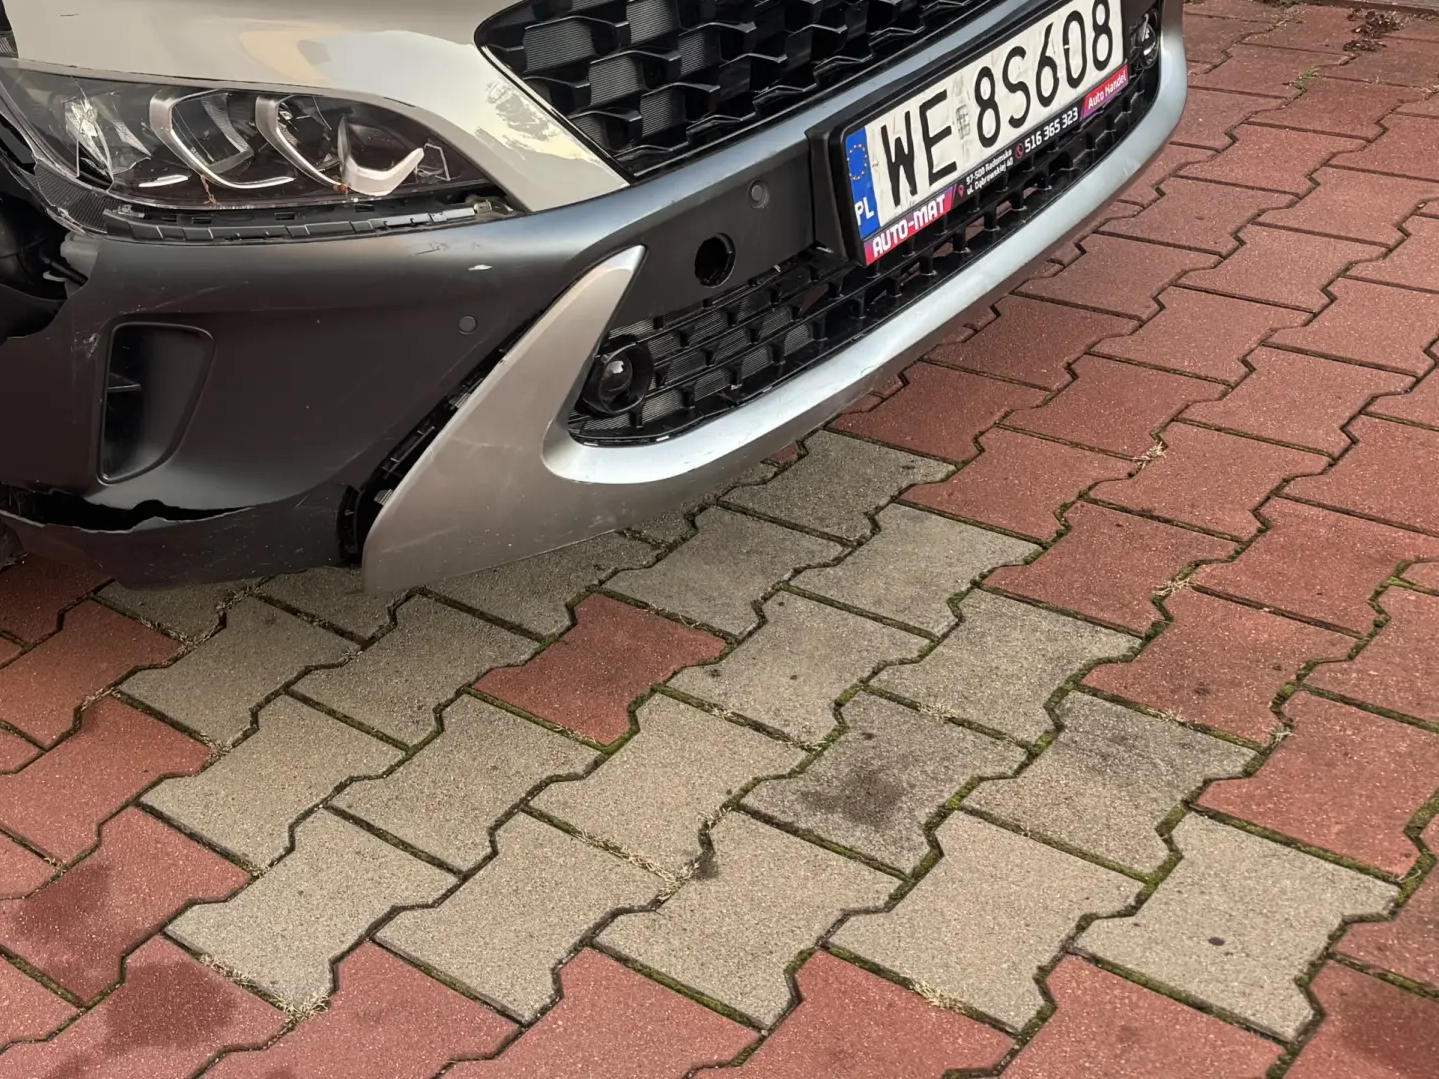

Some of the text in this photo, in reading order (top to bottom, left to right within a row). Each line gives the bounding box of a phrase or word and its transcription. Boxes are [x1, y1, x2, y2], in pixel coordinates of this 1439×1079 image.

[1087, 70, 1128, 110] Auto Handel
[880, 88, 958, 208] WE
[1024, 106, 1079, 153] 516 365 323
[854, 196, 875, 226] PL
[872, 193, 946, 258] AUTO-MAT
